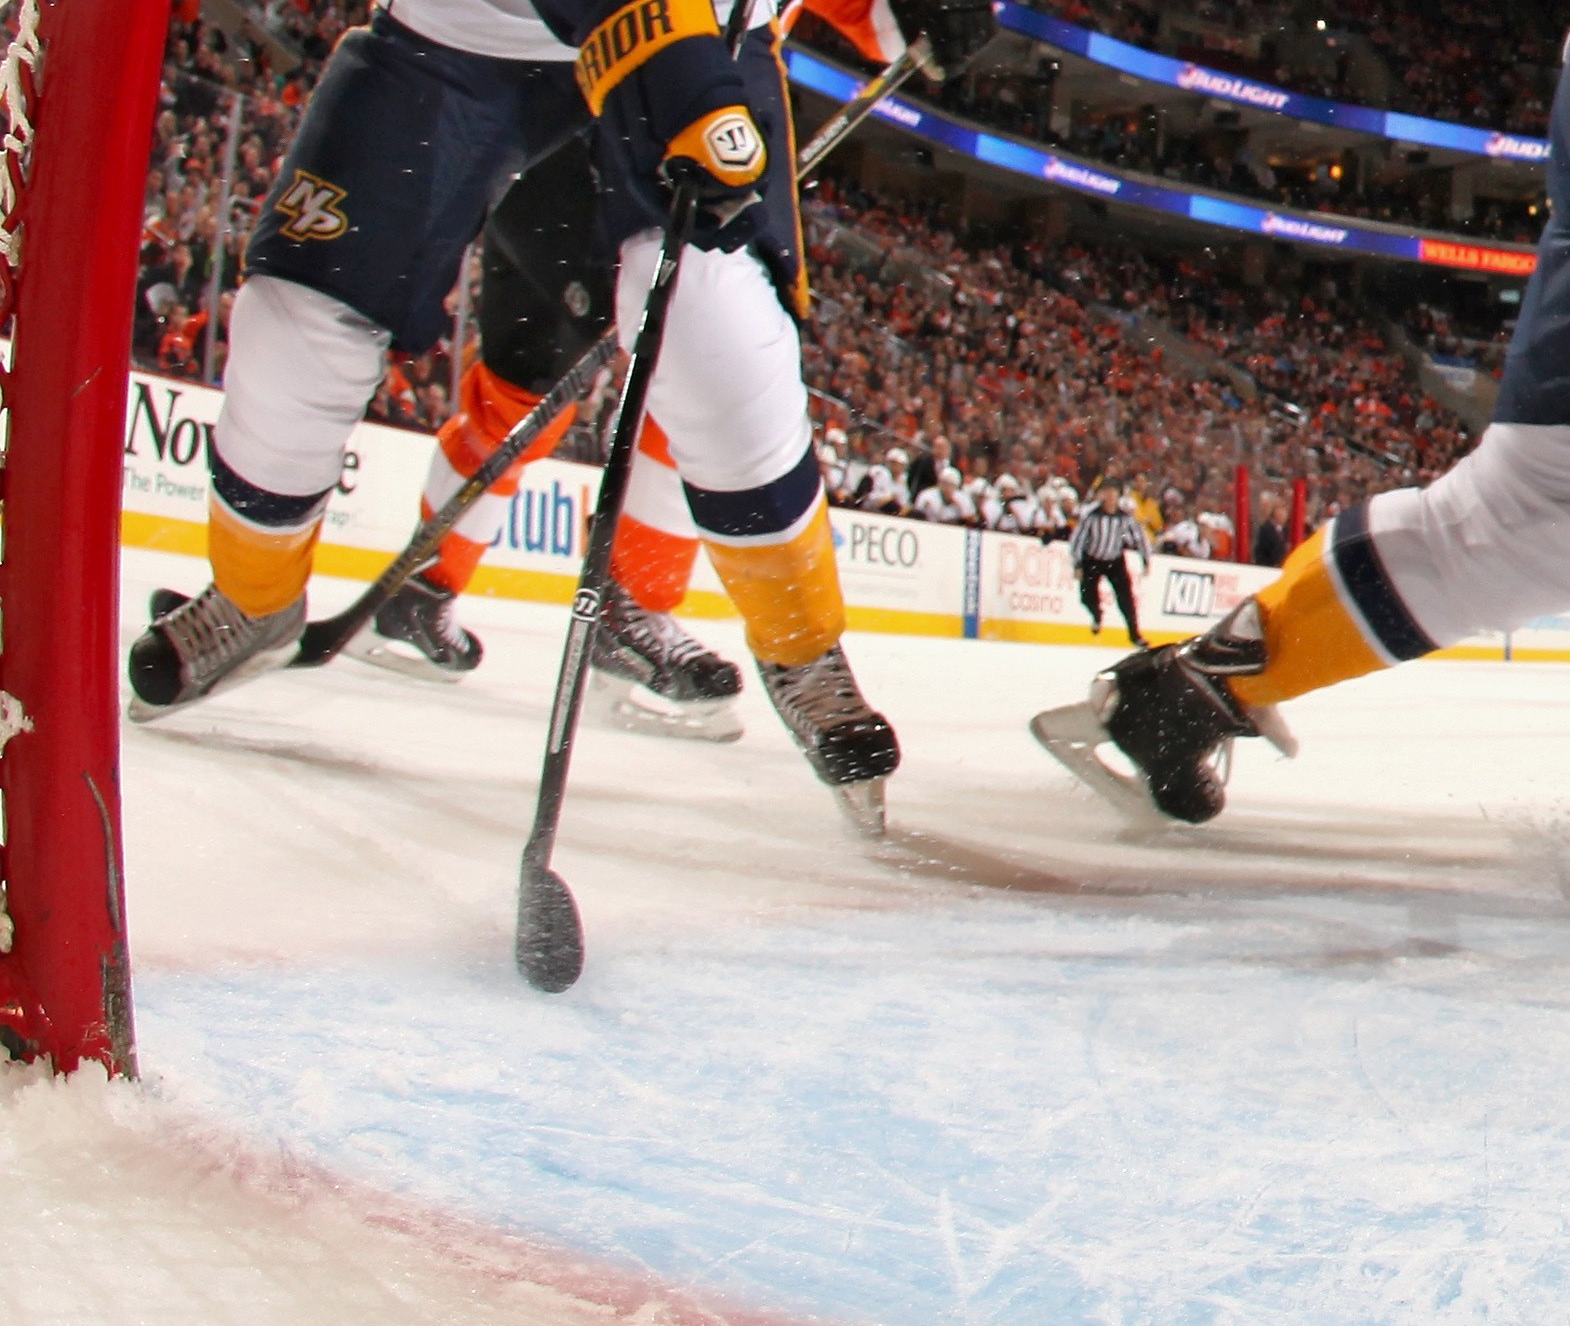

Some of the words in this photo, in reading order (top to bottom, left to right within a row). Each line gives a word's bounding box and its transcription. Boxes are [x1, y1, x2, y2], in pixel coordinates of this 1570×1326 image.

[1231, 77, 1290, 110] LIGHT
[1423, 240, 1480, 265] WELLS
[155, 472, 206, 502] Power
[850, 524, 919, 569] PECO
